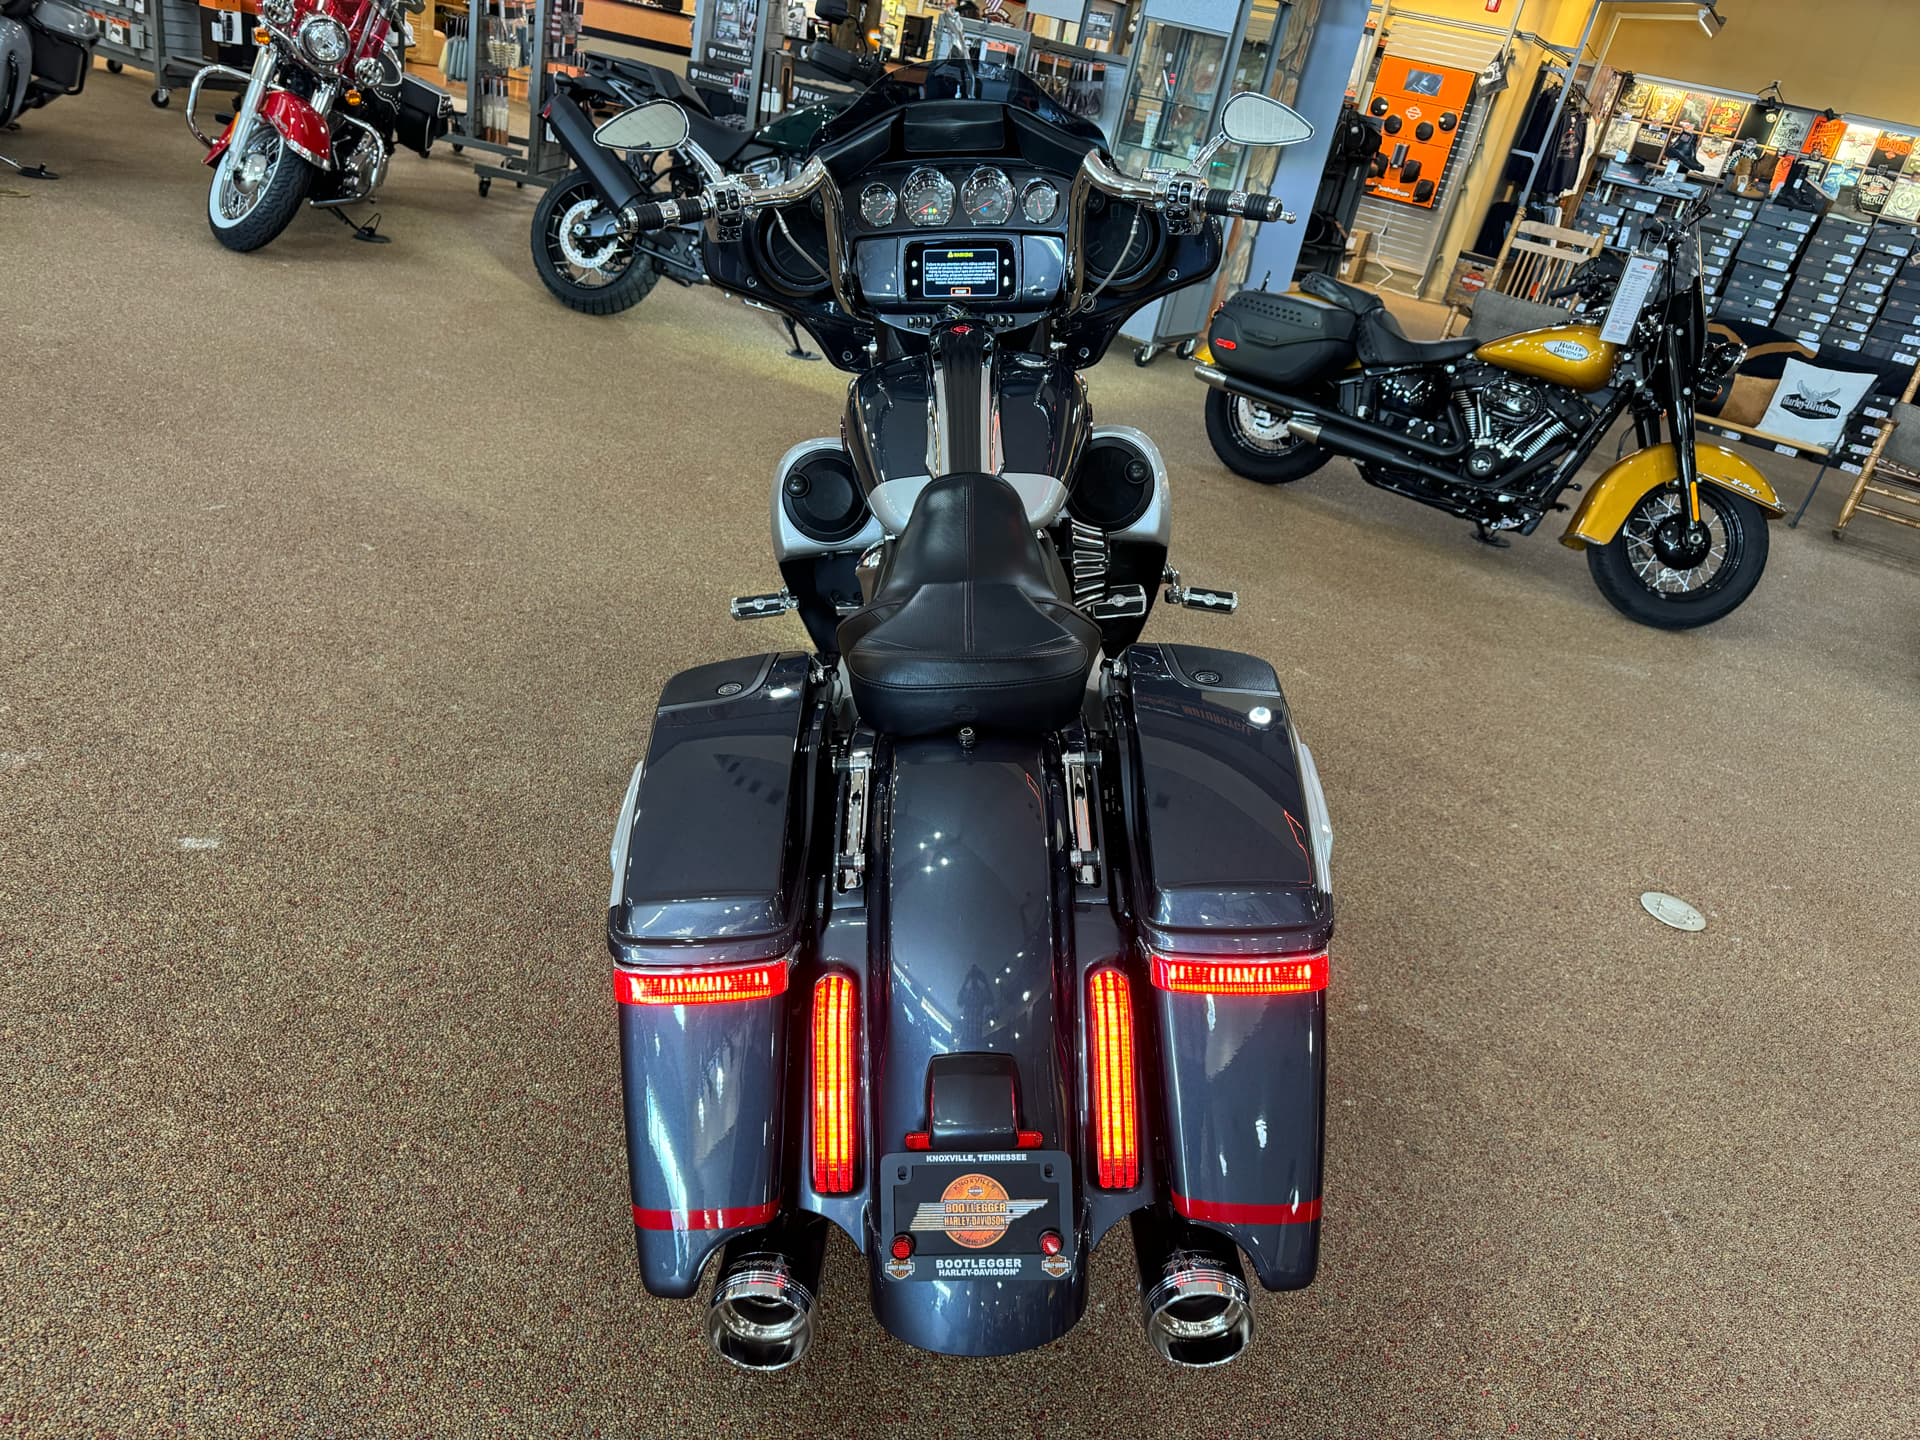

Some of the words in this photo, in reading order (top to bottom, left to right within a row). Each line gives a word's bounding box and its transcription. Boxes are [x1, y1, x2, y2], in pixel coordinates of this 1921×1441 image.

[800, 89, 813, 99] FAT
[1782, 396, 1840, 416] Harley-Davidson
[926, 1154, 977, 1163] KNOXVILLE,
[977, 1153, 1028, 1162] TENNESSEE
[945, 1202, 1007, 1213] BOOTLEGGER
[935, 1258, 1022, 1269] BOOTLEGGER
